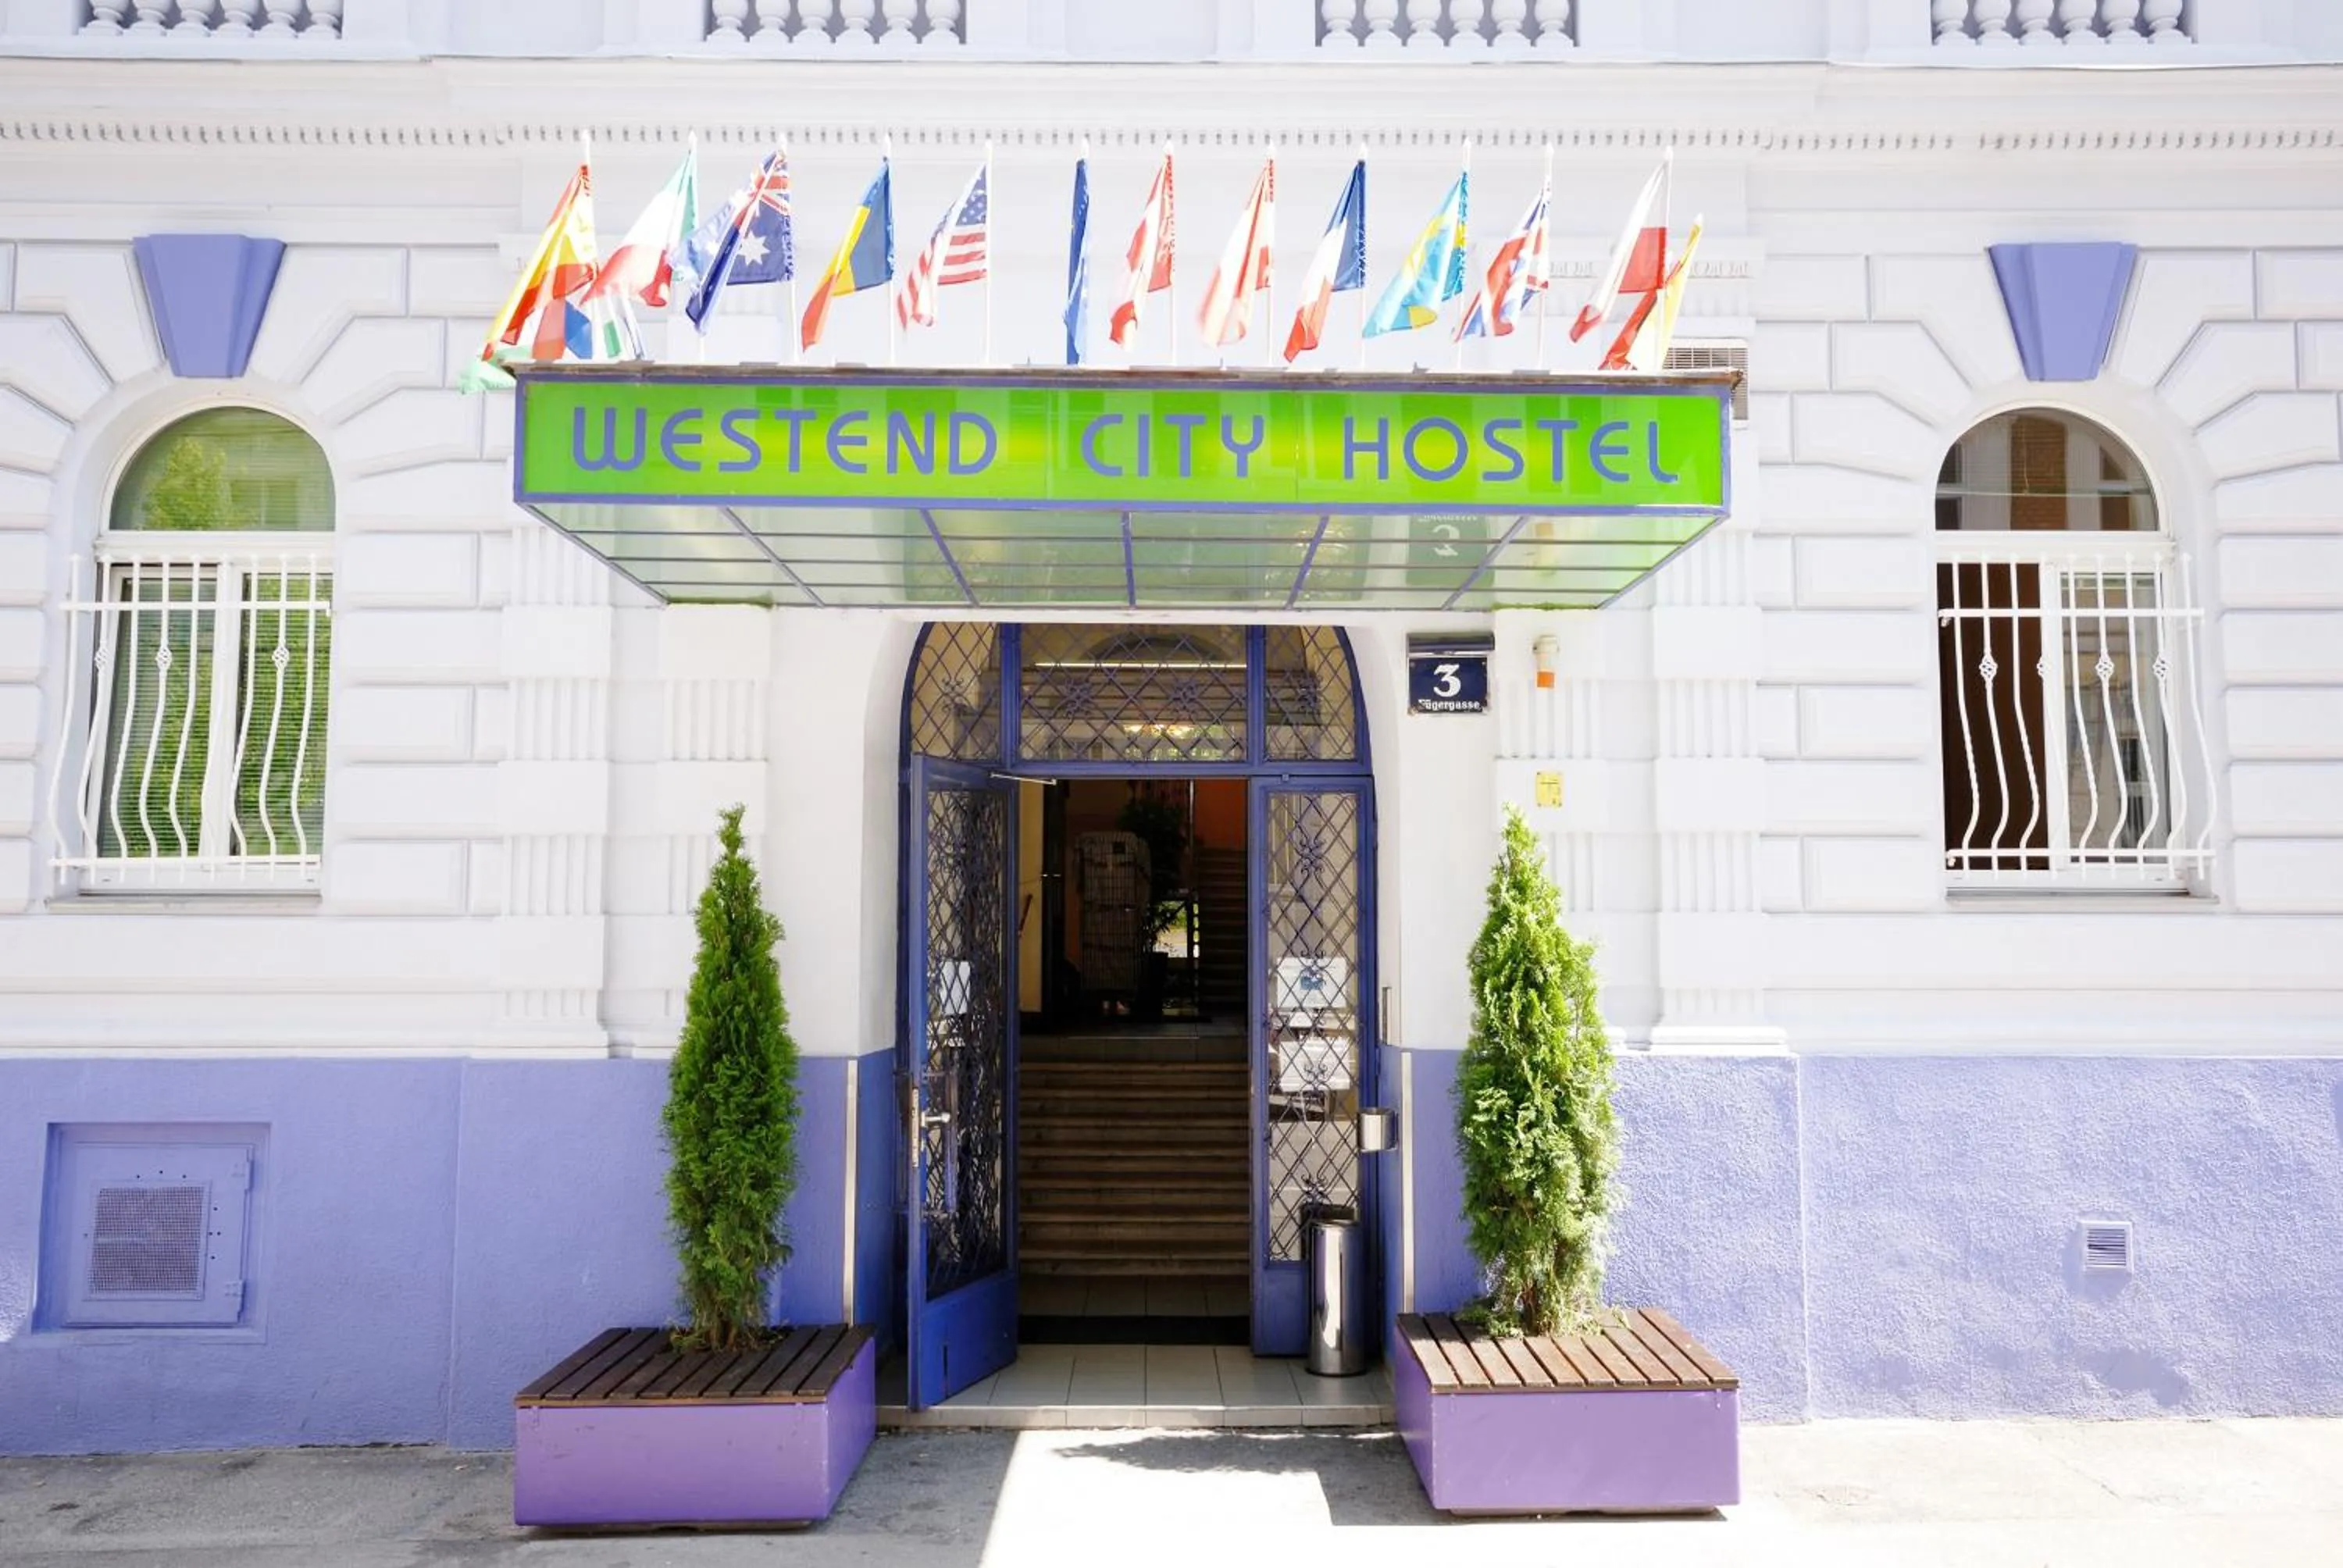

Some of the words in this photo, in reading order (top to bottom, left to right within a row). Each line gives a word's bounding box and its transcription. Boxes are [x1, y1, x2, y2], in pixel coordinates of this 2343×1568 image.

[575, 408, 996, 474] WESTEND
[1082, 415, 1263, 476] CITY
[1345, 418, 1676, 482] HOSTEL
[1433, 664, 1461, 697] 3
